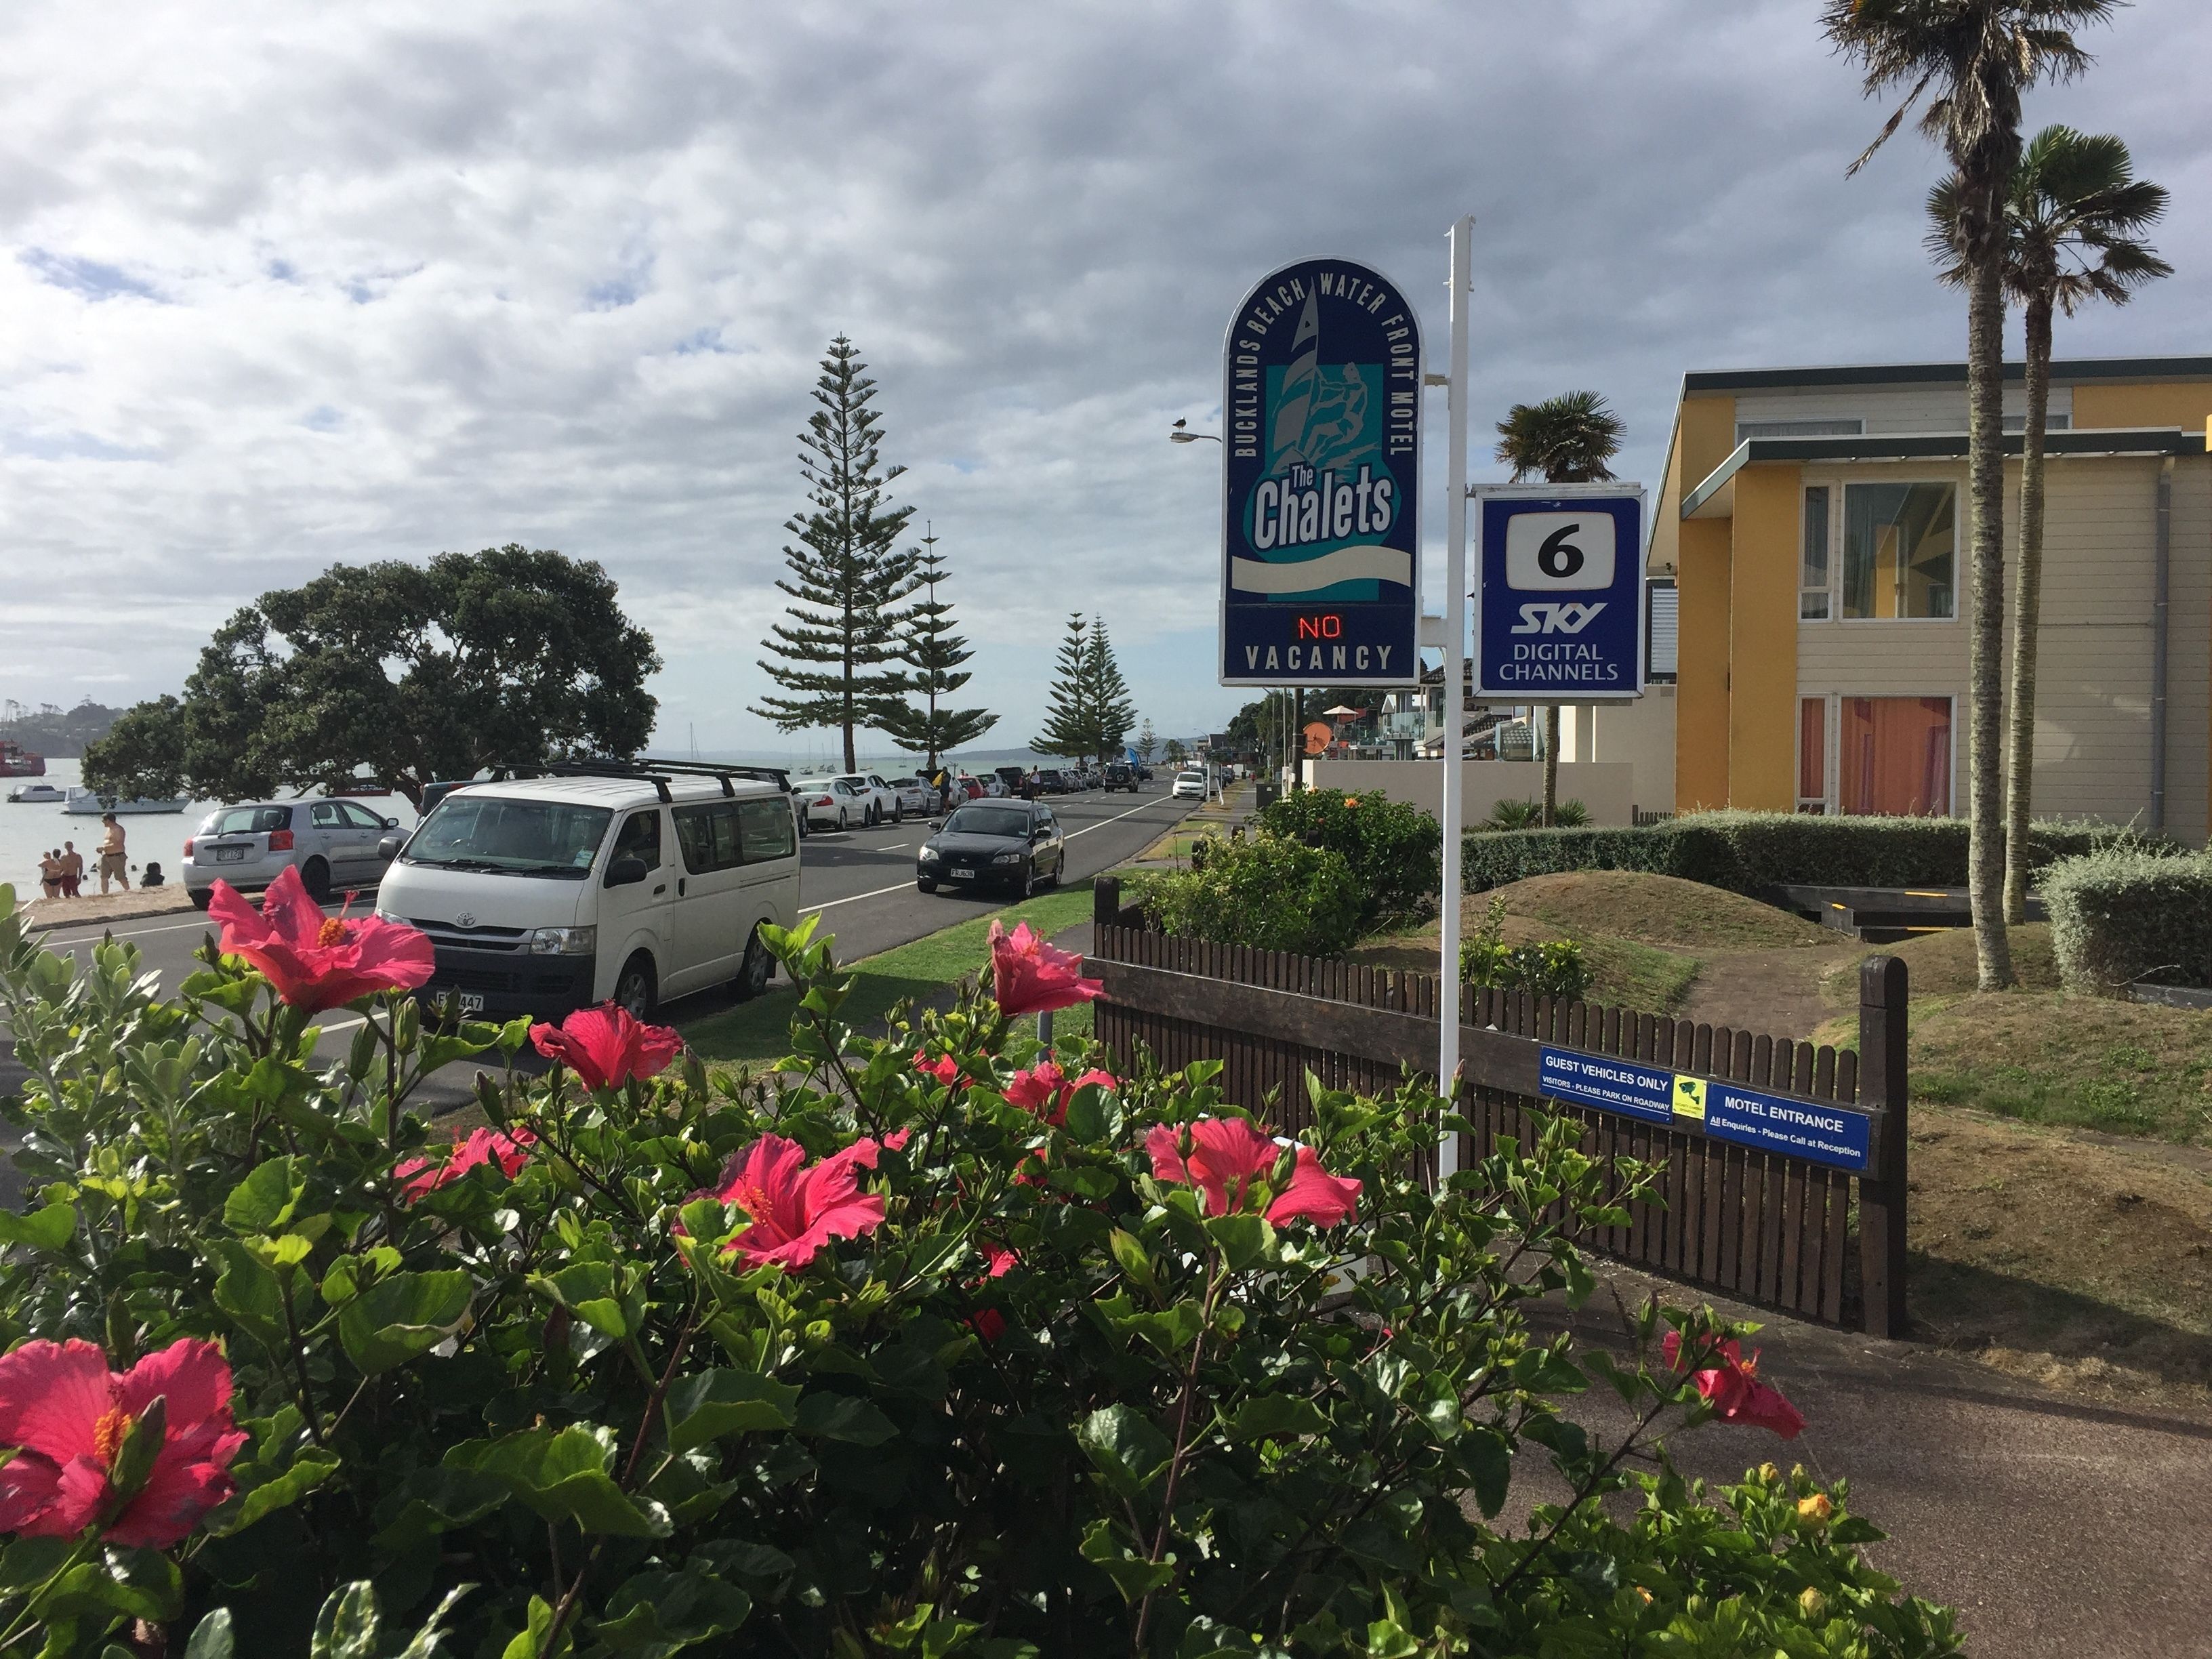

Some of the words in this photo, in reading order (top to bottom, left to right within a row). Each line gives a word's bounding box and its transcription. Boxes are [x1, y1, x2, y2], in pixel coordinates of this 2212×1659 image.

[1246, 278, 1307, 335] BEACH
[1320, 272, 1387, 314] WATER
[1381, 314, 1414, 380] FRONT
[1234, 339, 1261, 457] BUCKLANDS
[1390, 392, 1414, 455] MOTEL
[1292, 464, 1313, 488] The
[1254, 466, 1392, 549] Chalets
[1538, 523, 1584, 578] 6
[1298, 615, 1342, 639] NO
[1510, 602, 1609, 634] SKY
[1245, 645, 1393, 670] VACANCY
[1513, 643, 1603, 661] DIGITAL
[1499, 663, 1618, 680] CHANNELS
[438, 994, 482, 1008] F447
[1545, 1055, 1580, 1072] GUEST
[1581, 1063, 1635, 1084] VEHICLES
[1637, 1076, 1668, 1092] ONLY
[1542, 1076, 1571, 1088] VISITORS
[1575, 1084, 1601, 1096] PLEASE
[1602, 1090, 1620, 1101] PARK
[1622, 1094, 1633, 1103] ON
[1634, 1097, 1670, 1111] ROADWAY
[1725, 1096, 1767, 1116] MOTEL
[1769, 1107, 1843, 1133] ENTRANCE
[1710, 1116, 1721, 1125] All
[1722, 1118, 1757, 1134] Enquiries
[1762, 1128, 1788, 1141] Please
[1790, 1135, 1806, 1145] Call
[1807, 1139, 1816, 1147] at
[1818, 1141, 1860, 1158] Reception
